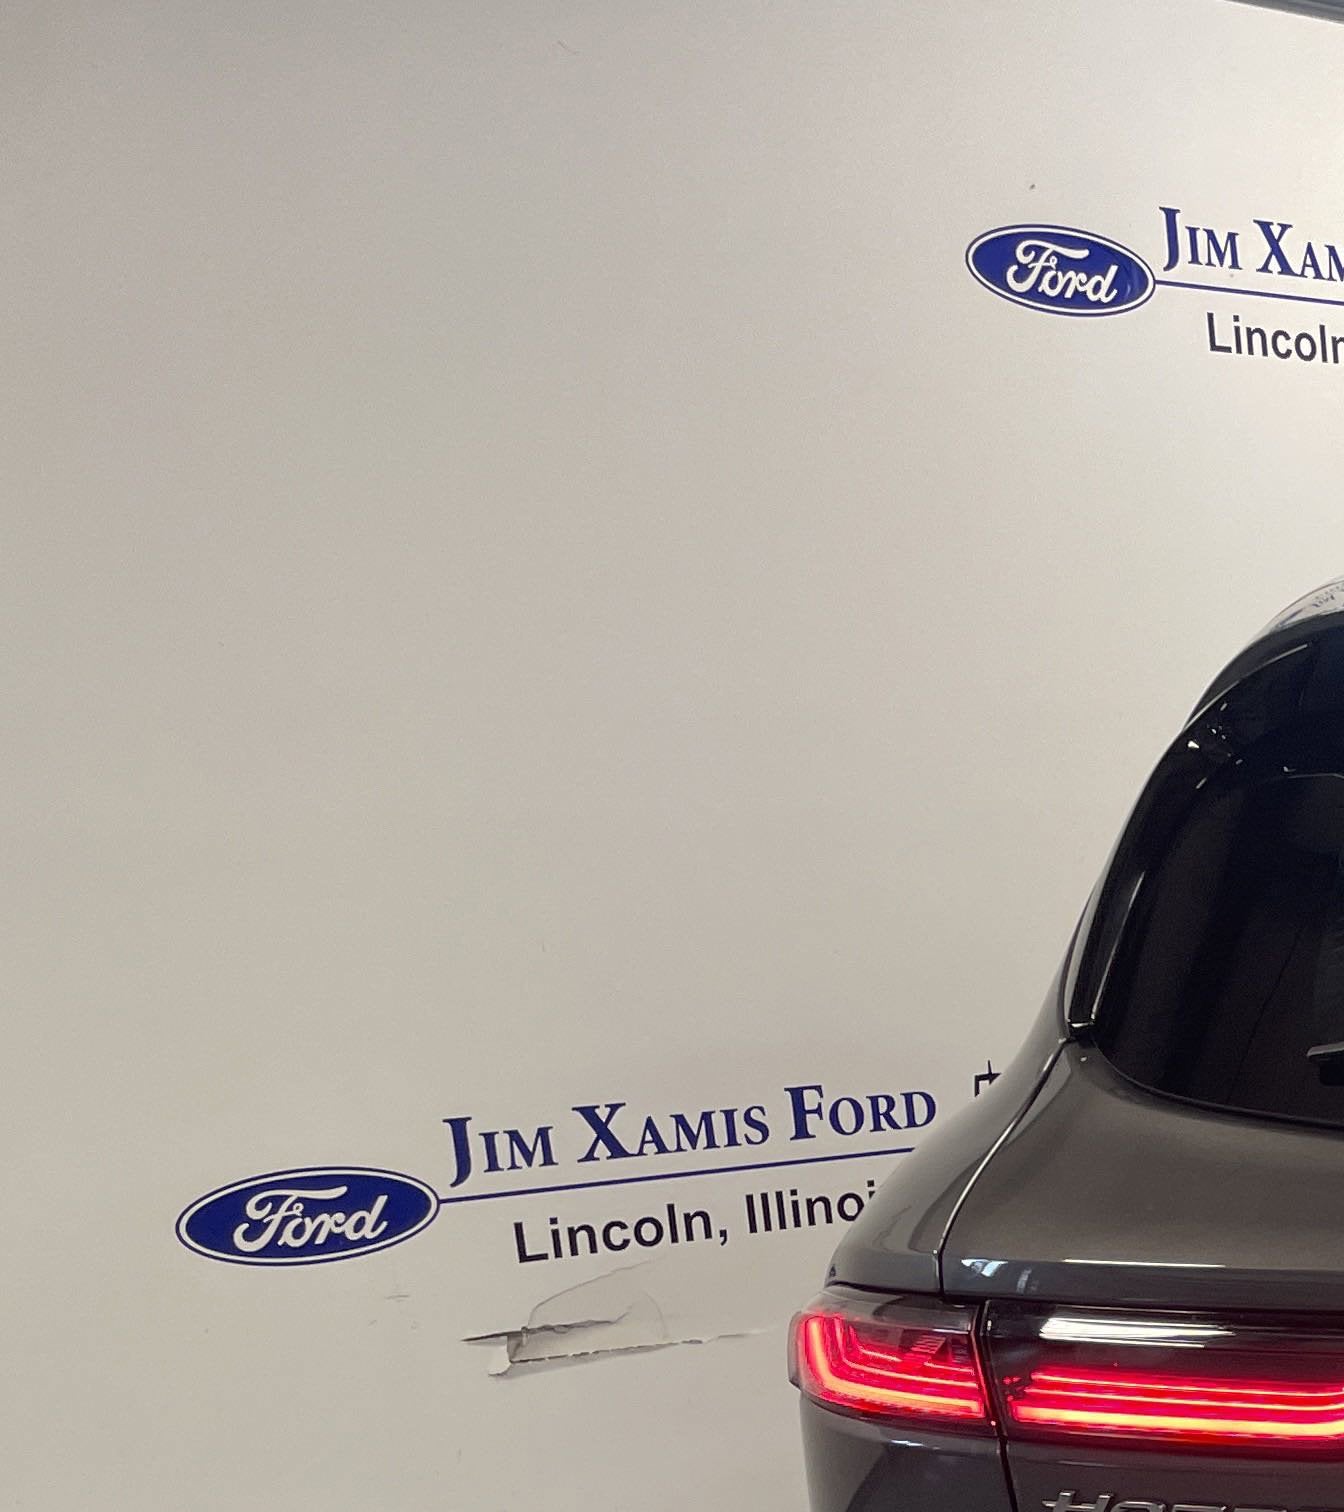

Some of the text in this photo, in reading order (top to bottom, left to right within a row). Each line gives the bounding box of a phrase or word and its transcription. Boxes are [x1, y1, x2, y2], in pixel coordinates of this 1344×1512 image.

[1006, 239, 1119, 304] Ford
[1159, 206, 1243, 272] JIM
[443, 1085, 937, 1188] JIM XAMIS FORD
[233, 1185, 387, 1253] Ford
[514, 1180, 875, 1264] Lincoln, Illino
